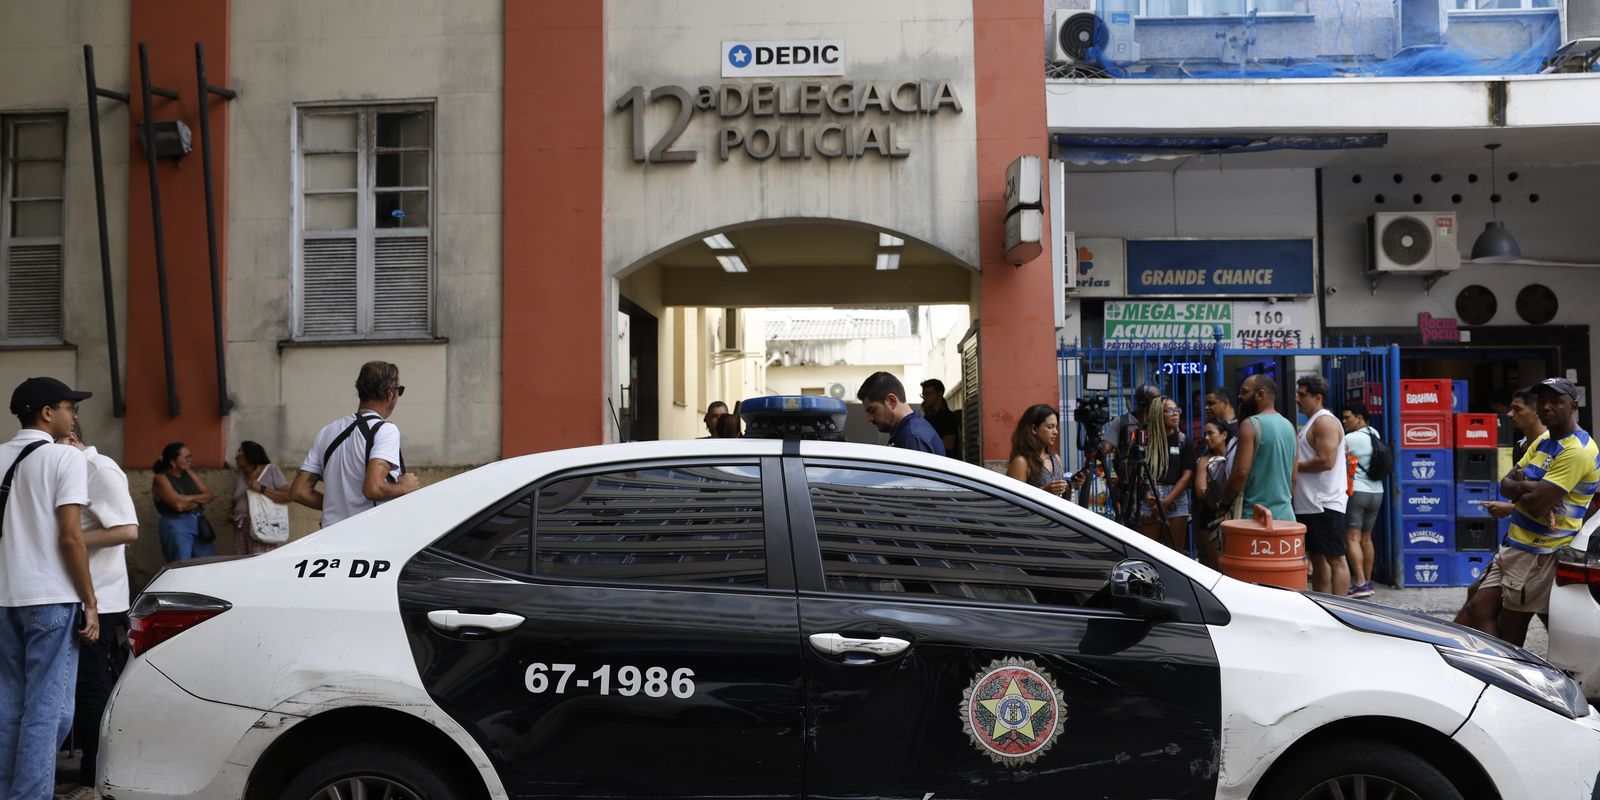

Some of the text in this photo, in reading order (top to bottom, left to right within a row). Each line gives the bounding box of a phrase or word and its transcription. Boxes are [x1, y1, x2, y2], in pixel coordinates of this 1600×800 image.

[755, 45, 839, 65] DEDIC
[719, 78, 963, 118] DELEGACIA
[718, 122, 911, 161] POLICIAL
[1141, 269, 1273, 286] GRANDE CHANCE
[1122, 303, 1232, 320] MEGA-SENA
[1255, 311, 1283, 325] 160
[1237, 327, 1301, 338] MILHÕES
[1406, 393, 1439, 404] BRAHMA
[1408, 496, 1440, 505] ambev
[1250, 539, 1275, 555] 12
[295, 558, 391, 579] 12ª DP
[524, 662, 696, 699] 67-1986
